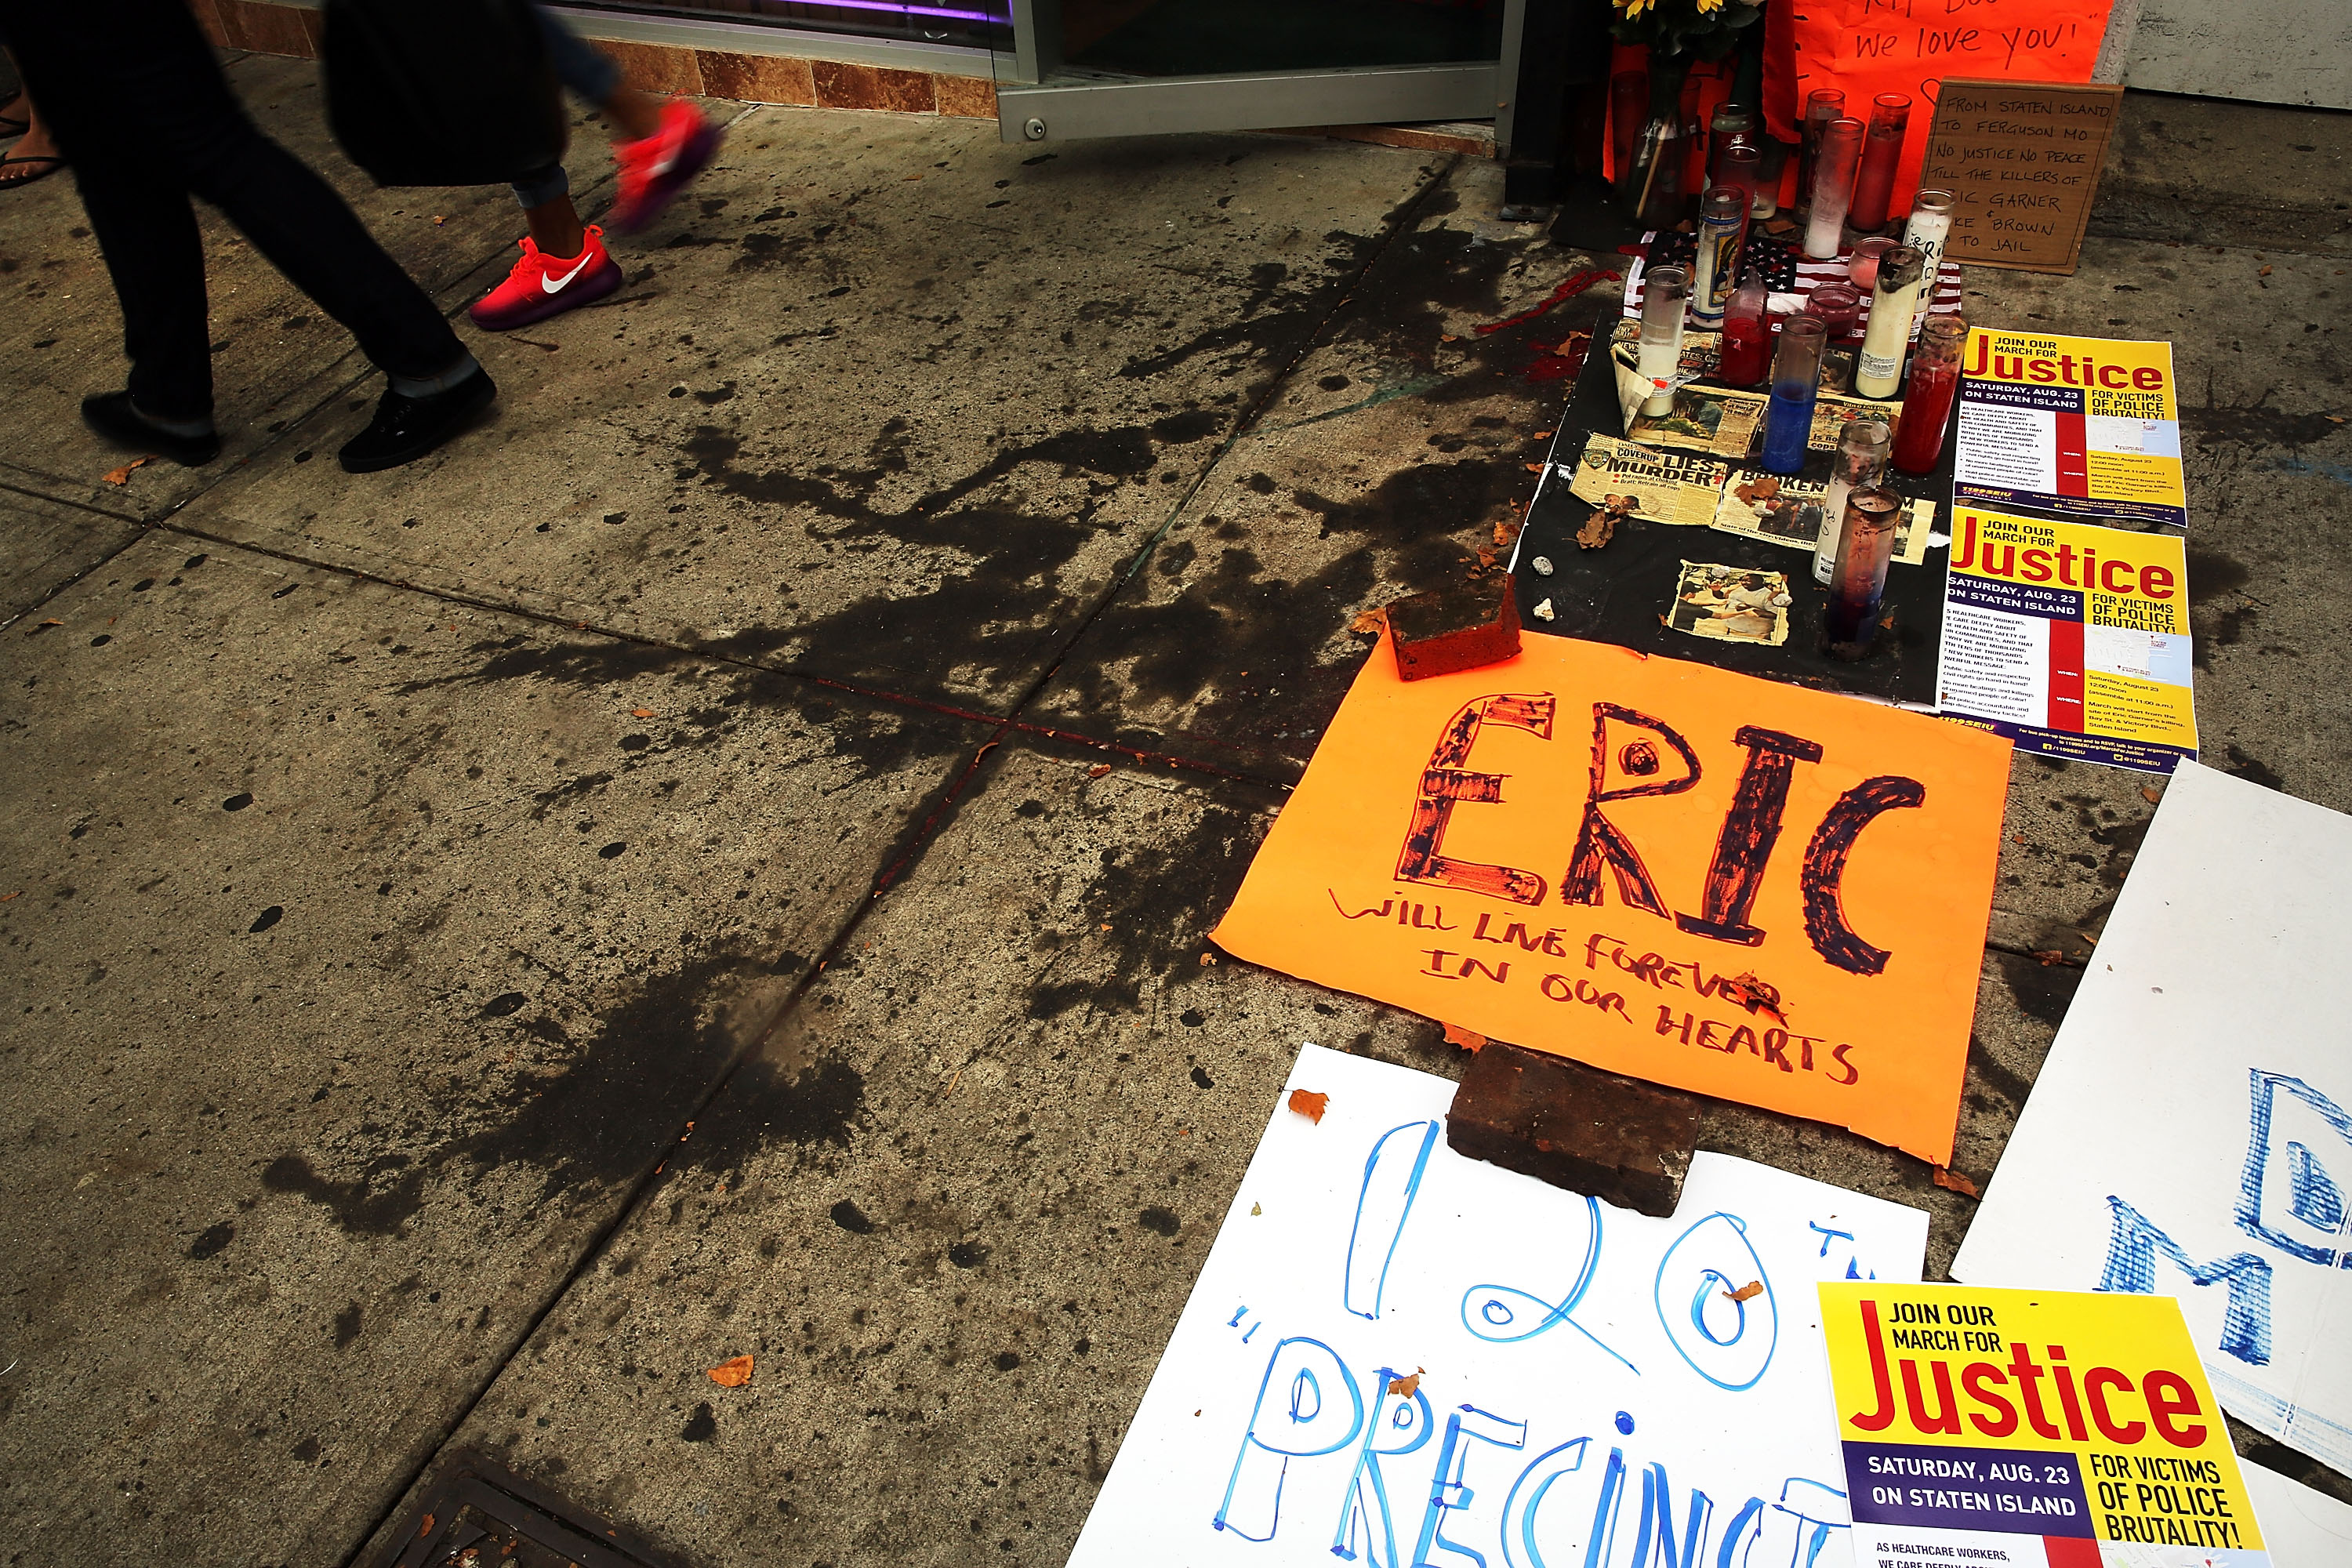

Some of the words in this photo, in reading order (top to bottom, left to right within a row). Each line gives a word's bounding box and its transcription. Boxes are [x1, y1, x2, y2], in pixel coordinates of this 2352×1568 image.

[1917, 27, 1981, 58] love
[1946, 98, 1987, 113] FROM
[2000, 100, 2052, 114] STATEN
[2060, 104, 2110, 118] ISLAND
[1941, 119, 1960, 130] TO
[1976, 122, 2053, 137] FERGUSON
[2064, 129, 2087, 140] MO
[1936, 142, 1954, 157] NO
[1960, 147, 2014, 164] JUSTICE
[2020, 148, 2036, 162] NO
[2045, 151, 2085, 163] PEACE
[1931, 166, 1959, 179] TILL
[1965, 169, 1991, 180] THE
[2001, 171, 2058, 185] KILLERS
[2062, 176, 2082, 185] OF
[1954, 190, 1978, 203] IC
[1990, 194, 2061, 212] GARNER
[1955, 218, 1975, 227] KE
[1992, 219, 2055, 235] BROWN
[1960, 236, 1979, 246] TO
[1991, 239, 2031, 252] JAIL
[1994, 337, 2027, 346] JOIN
[2030, 340, 2056, 349] OUR
[1994, 346, 2032, 355] MARCH
[1963, 335, 2163, 390] Justice
[1966, 382, 2031, 395] SATURDAY,
[2034, 387, 2062, 397] AUG.
[2117, 393, 2163, 401] VICTIMS
[1986, 394, 2031, 403] STATEN
[2034, 398, 2078, 408] ISLAND
[2092, 399, 2111, 408] OF
[2114, 401, 2164, 412] POLICE
[2092, 408, 2165, 420] BRUTALITY!
[1617, 448, 1659, 463] COVERUP
[1984, 520, 2018, 532] JOIN
[2023, 526, 2054, 536] OUR
[1984, 531, 2027, 543] MARCH
[2031, 537, 2054, 547] FOR
[1951, 516, 2175, 599] Justice
[1949, 576, 2020, 597] SATURDAY,
[2026, 590, 2056, 601] AUG.
[2060, 595, 2076, 604] 23
[1948, 589, 1966, 598] ON
[1970, 592, 2021, 608] STATEN
[2025, 601, 2076, 615] ISLAND
[2092, 593, 2117, 604] FOR
[2122, 598, 2173, 613] VICTIMS
[1953, 610, 1991, 621] HEALTHCARE
[1994, 617, 2026, 626] WORKERS,
[2093, 604, 2113, 615] OF
[2118, 608, 2175, 625] POLICE
[2093, 615, 2176, 635] BRUTALITY!
[1990, 644, 2027, 652] MOBILIZING
[2089, 674, 2122, 686] Saturday,
[2123, 681, 2148, 691] August
[2089, 689, 2124, 701] (assemble
[2123, 719, 2149, 728] Victory
[2129, 714, 2159, 723] Garner's
[2161, 719, 2185, 728] killing,
[1392, 691, 1927, 975] ERIC
[1328, 888, 1457, 931] WILL
[1472, 912, 1567, 957] LIVE
[1420, 949, 1511, 984] IN
[1541, 973, 1632, 1024] OUR
[1656, 1004, 1859, 1086] HEARTS
[1889, 1302, 1941, 1324] JOIN
[1947, 1305, 1997, 1327] OUR
[1893, 1329, 1960, 1351] MARCH
[1966, 1331, 2003, 1353] FOR
[1849, 1300, 2208, 1449] Justice
[1868, 1456, 1984, 1483] SATURDAY,
[1989, 1463, 2040, 1483] AUG.
[2045, 1465, 2070, 1485] 23
[2090, 1454, 2130, 1478] FOR
[2137, 1457, 2220, 1484] VICTIMS
[1873, 1487, 1904, 1505] ON
[1911, 1489, 1991, 1512] STATEN
[1996, 1494, 2076, 1517] ISLAND
[2098, 1481, 2129, 1510] OF
[2140, 1485, 2233, 1517] POLICE
[2107, 1515, 2241, 1549] BRUTALITY!
[1877, 1542, 1889, 1552] AS
[1893, 1543, 1955, 1556] HEALTHCARE
[1957, 1548, 2010, 1563] WORKERS,
